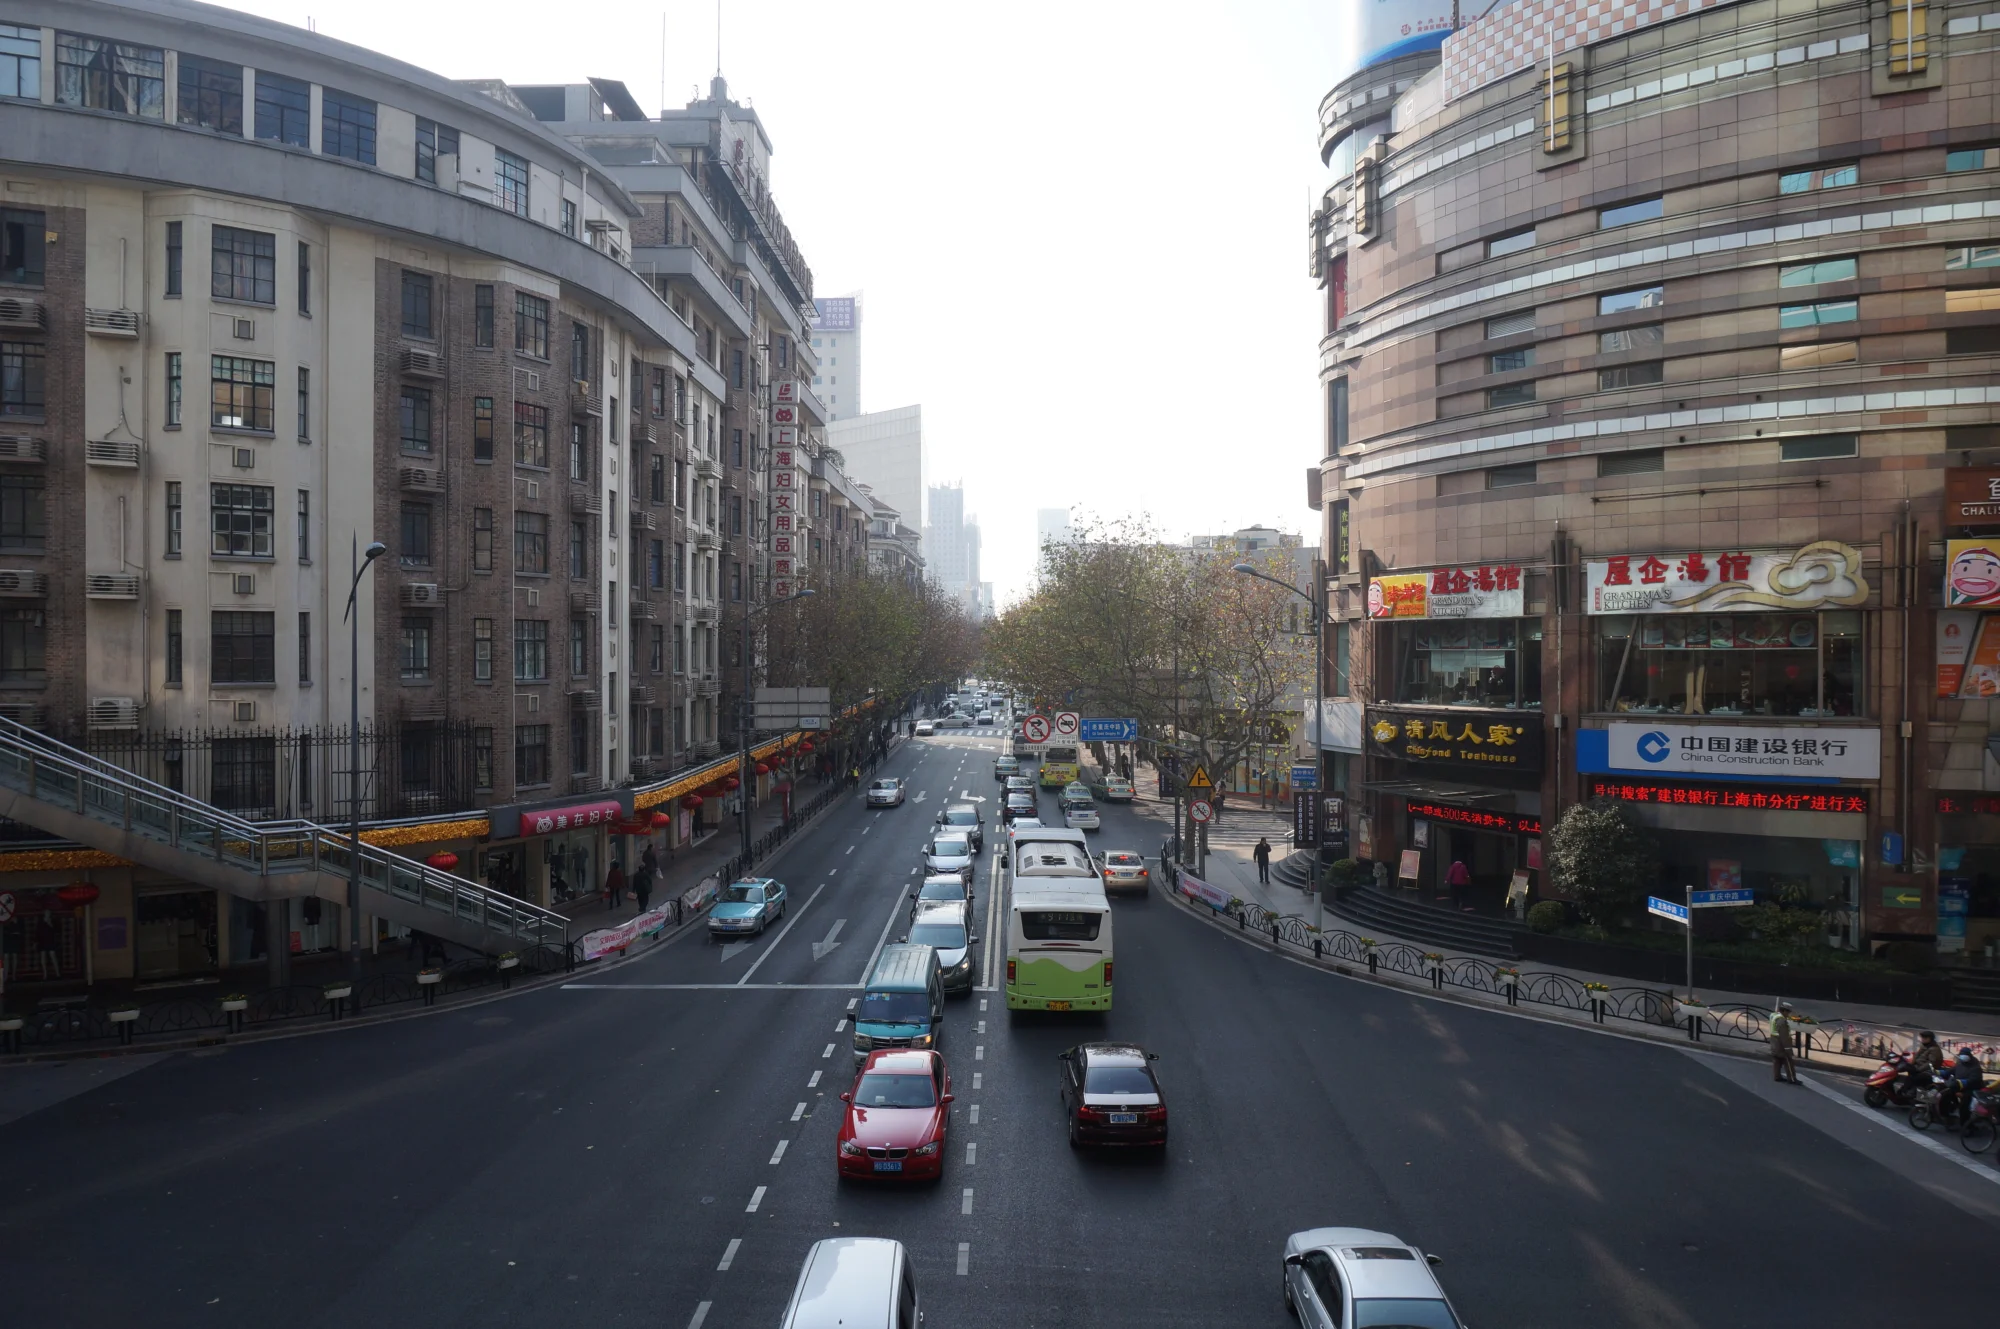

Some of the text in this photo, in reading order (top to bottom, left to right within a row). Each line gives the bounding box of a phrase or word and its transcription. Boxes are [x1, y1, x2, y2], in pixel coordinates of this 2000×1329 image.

[775, 429, 791, 598] 上海妇女用品商店
[1431, 607, 1467, 617] KITCHEN
[1603, 600, 1653, 611] KITCHEN
[1405, 719, 1517, 746] 清风人家
[1681, 735, 1848, 757] 中国建设银行
[1460, 750, 1517, 763] Teahouse
[1681, 752, 1825, 767] China Construction Bank
[556, 808, 614, 830] 美在妇女
[1709, 892, 1739, 901] 重庆中路
